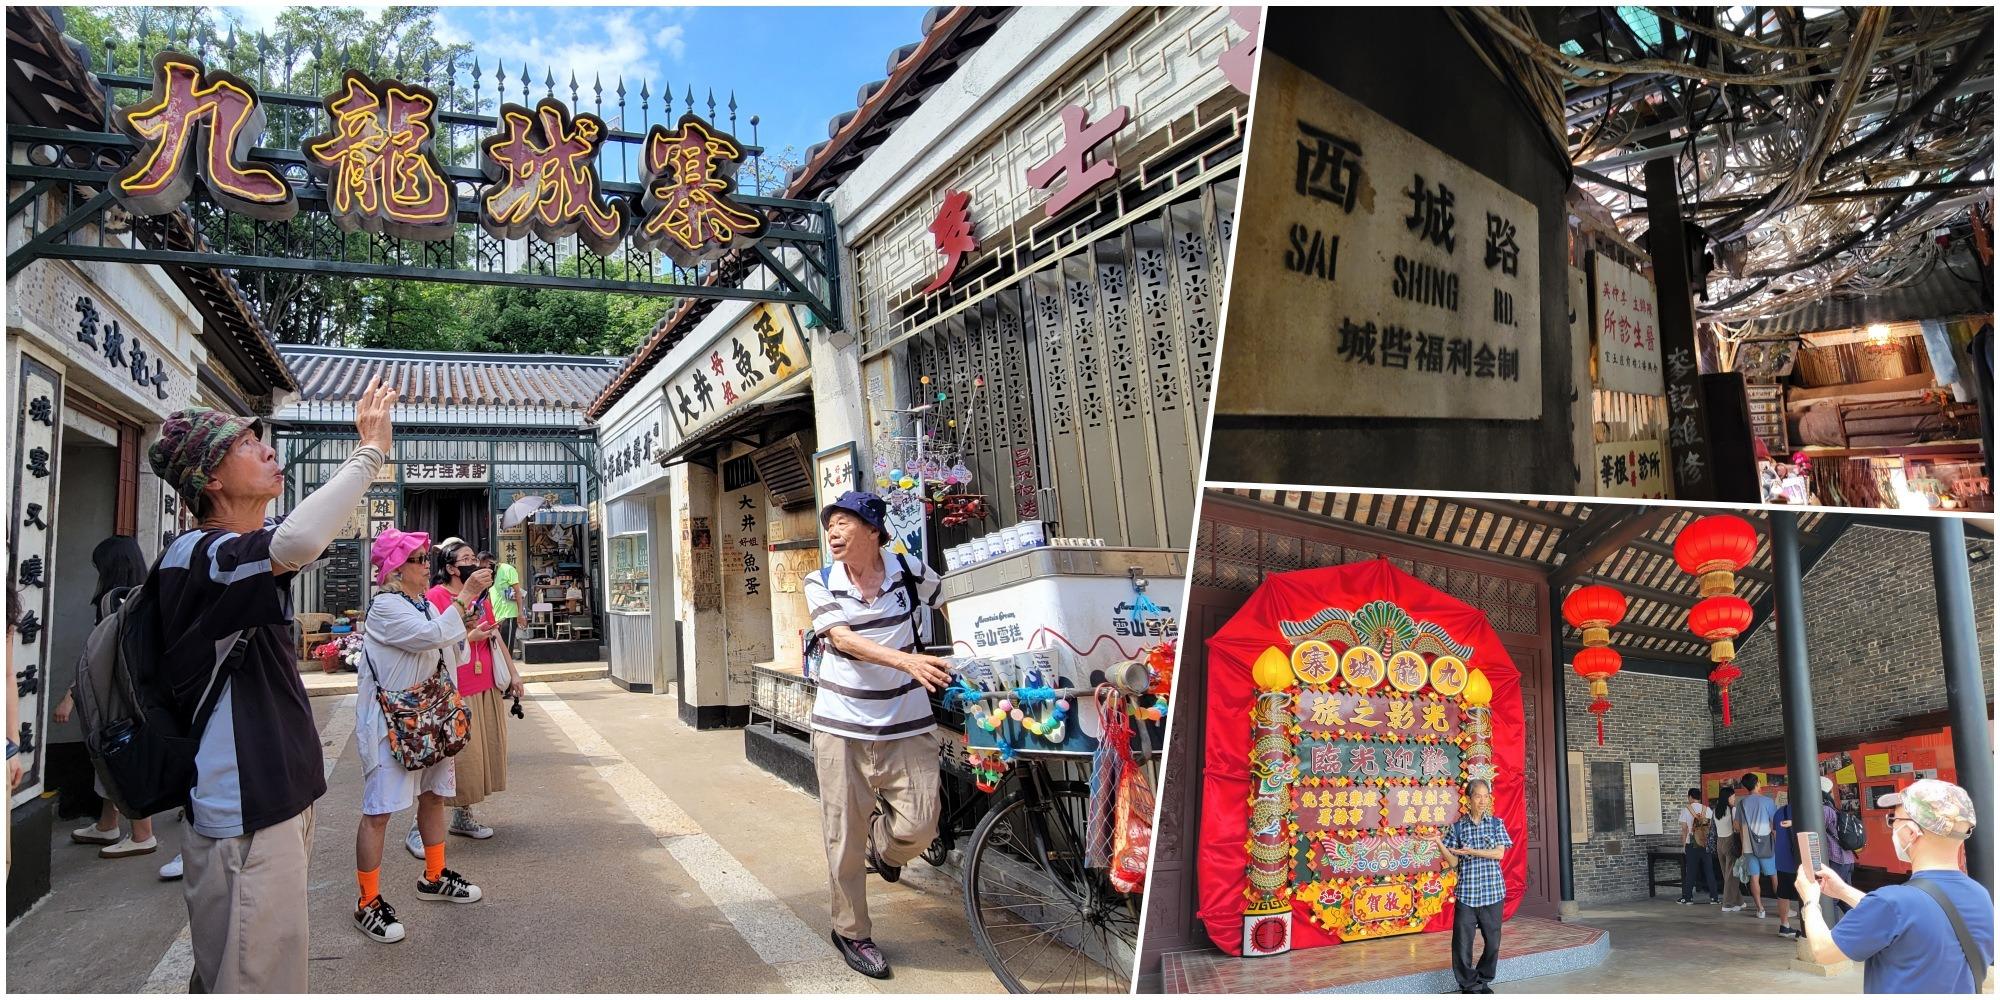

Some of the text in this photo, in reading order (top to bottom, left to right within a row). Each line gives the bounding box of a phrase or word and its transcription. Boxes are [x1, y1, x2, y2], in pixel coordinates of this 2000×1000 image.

[117, 58, 765, 252] 九龍城寨
[1294, 117, 1520, 278] 西城路
[1285, 223, 1519, 328] SAI SHING RD.
[974, 623, 1024, 647] 雪山雪糕
[1301, 645, 1463, 688] 九龍城寨
[1308, 693, 1450, 732] 光影之旅
[1311, 742, 1452, 776] 歡迎光臨
